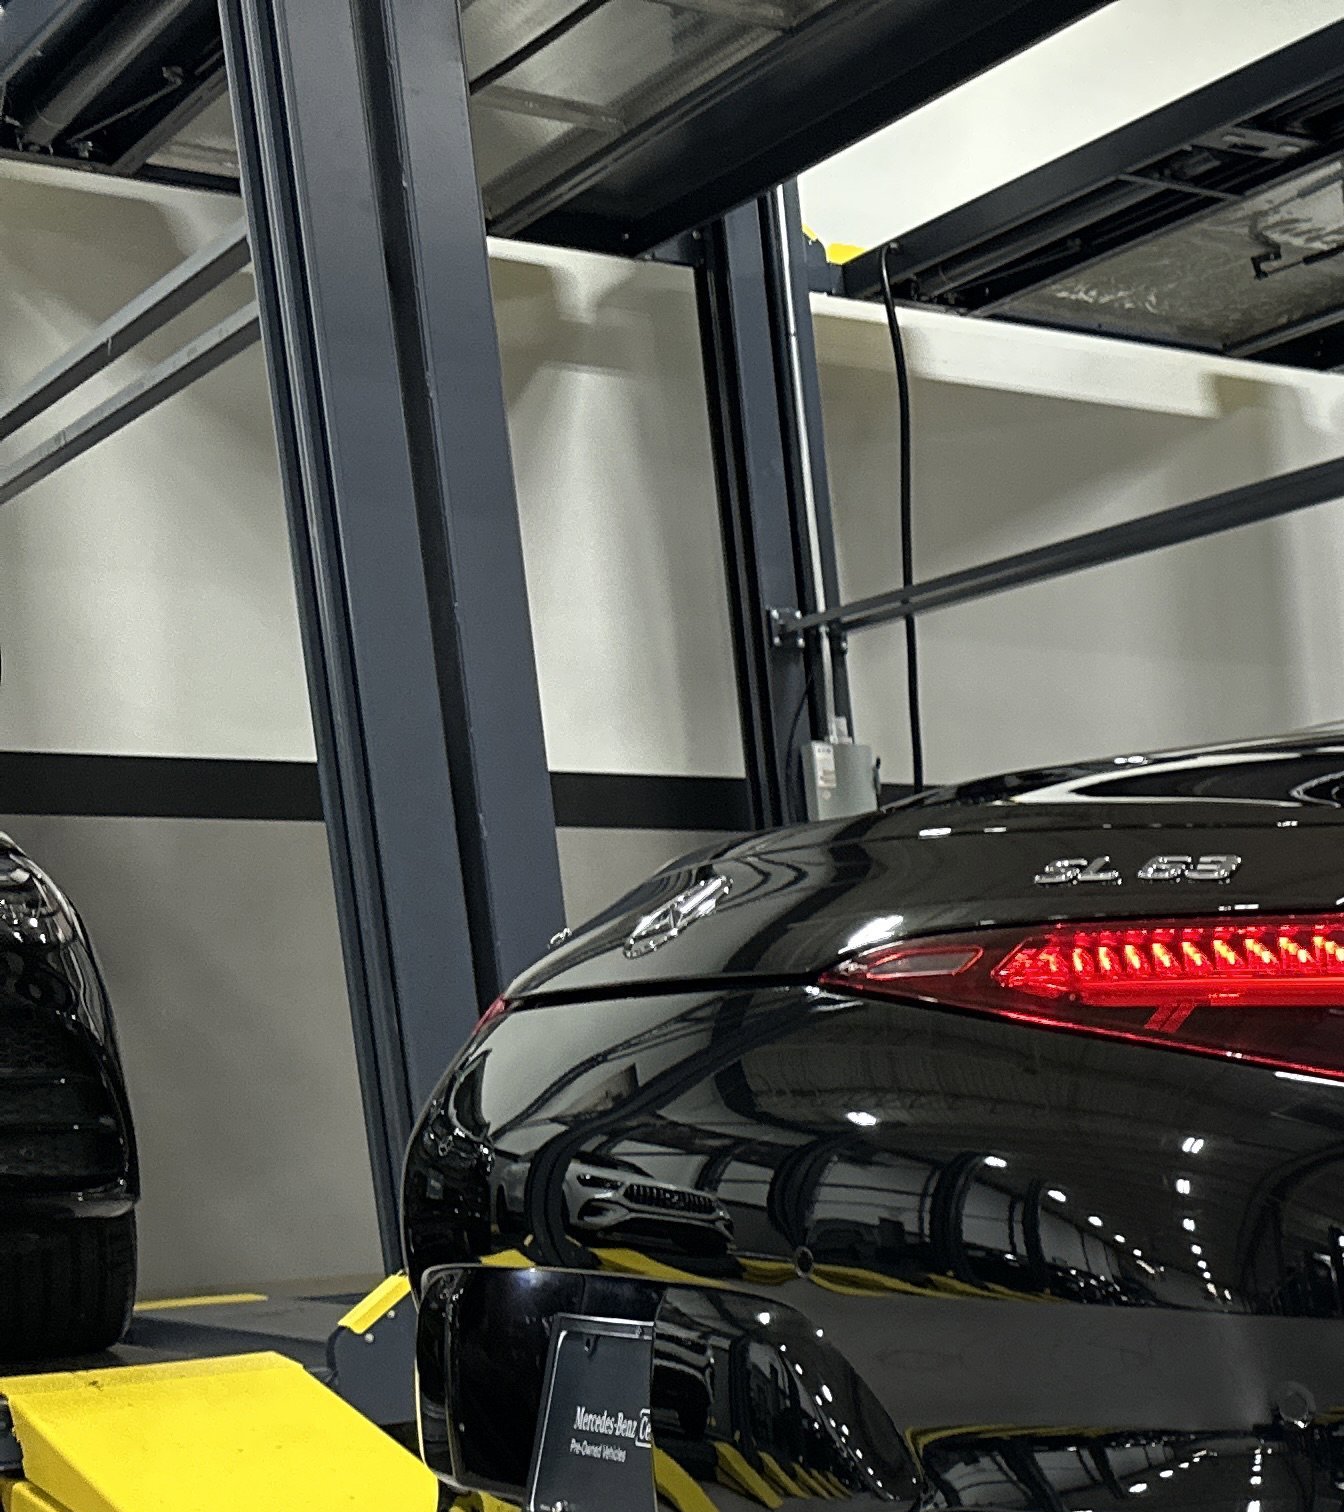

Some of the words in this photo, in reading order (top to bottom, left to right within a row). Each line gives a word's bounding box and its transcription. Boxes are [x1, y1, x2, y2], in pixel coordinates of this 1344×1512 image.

[1034, 855, 1122, 885] SL
[1137, 854, 1242, 883] 63
[573, 1406, 637, 1438] Mercedes-Benz
[570, 1438, 601, 1458] Pre-Owned
